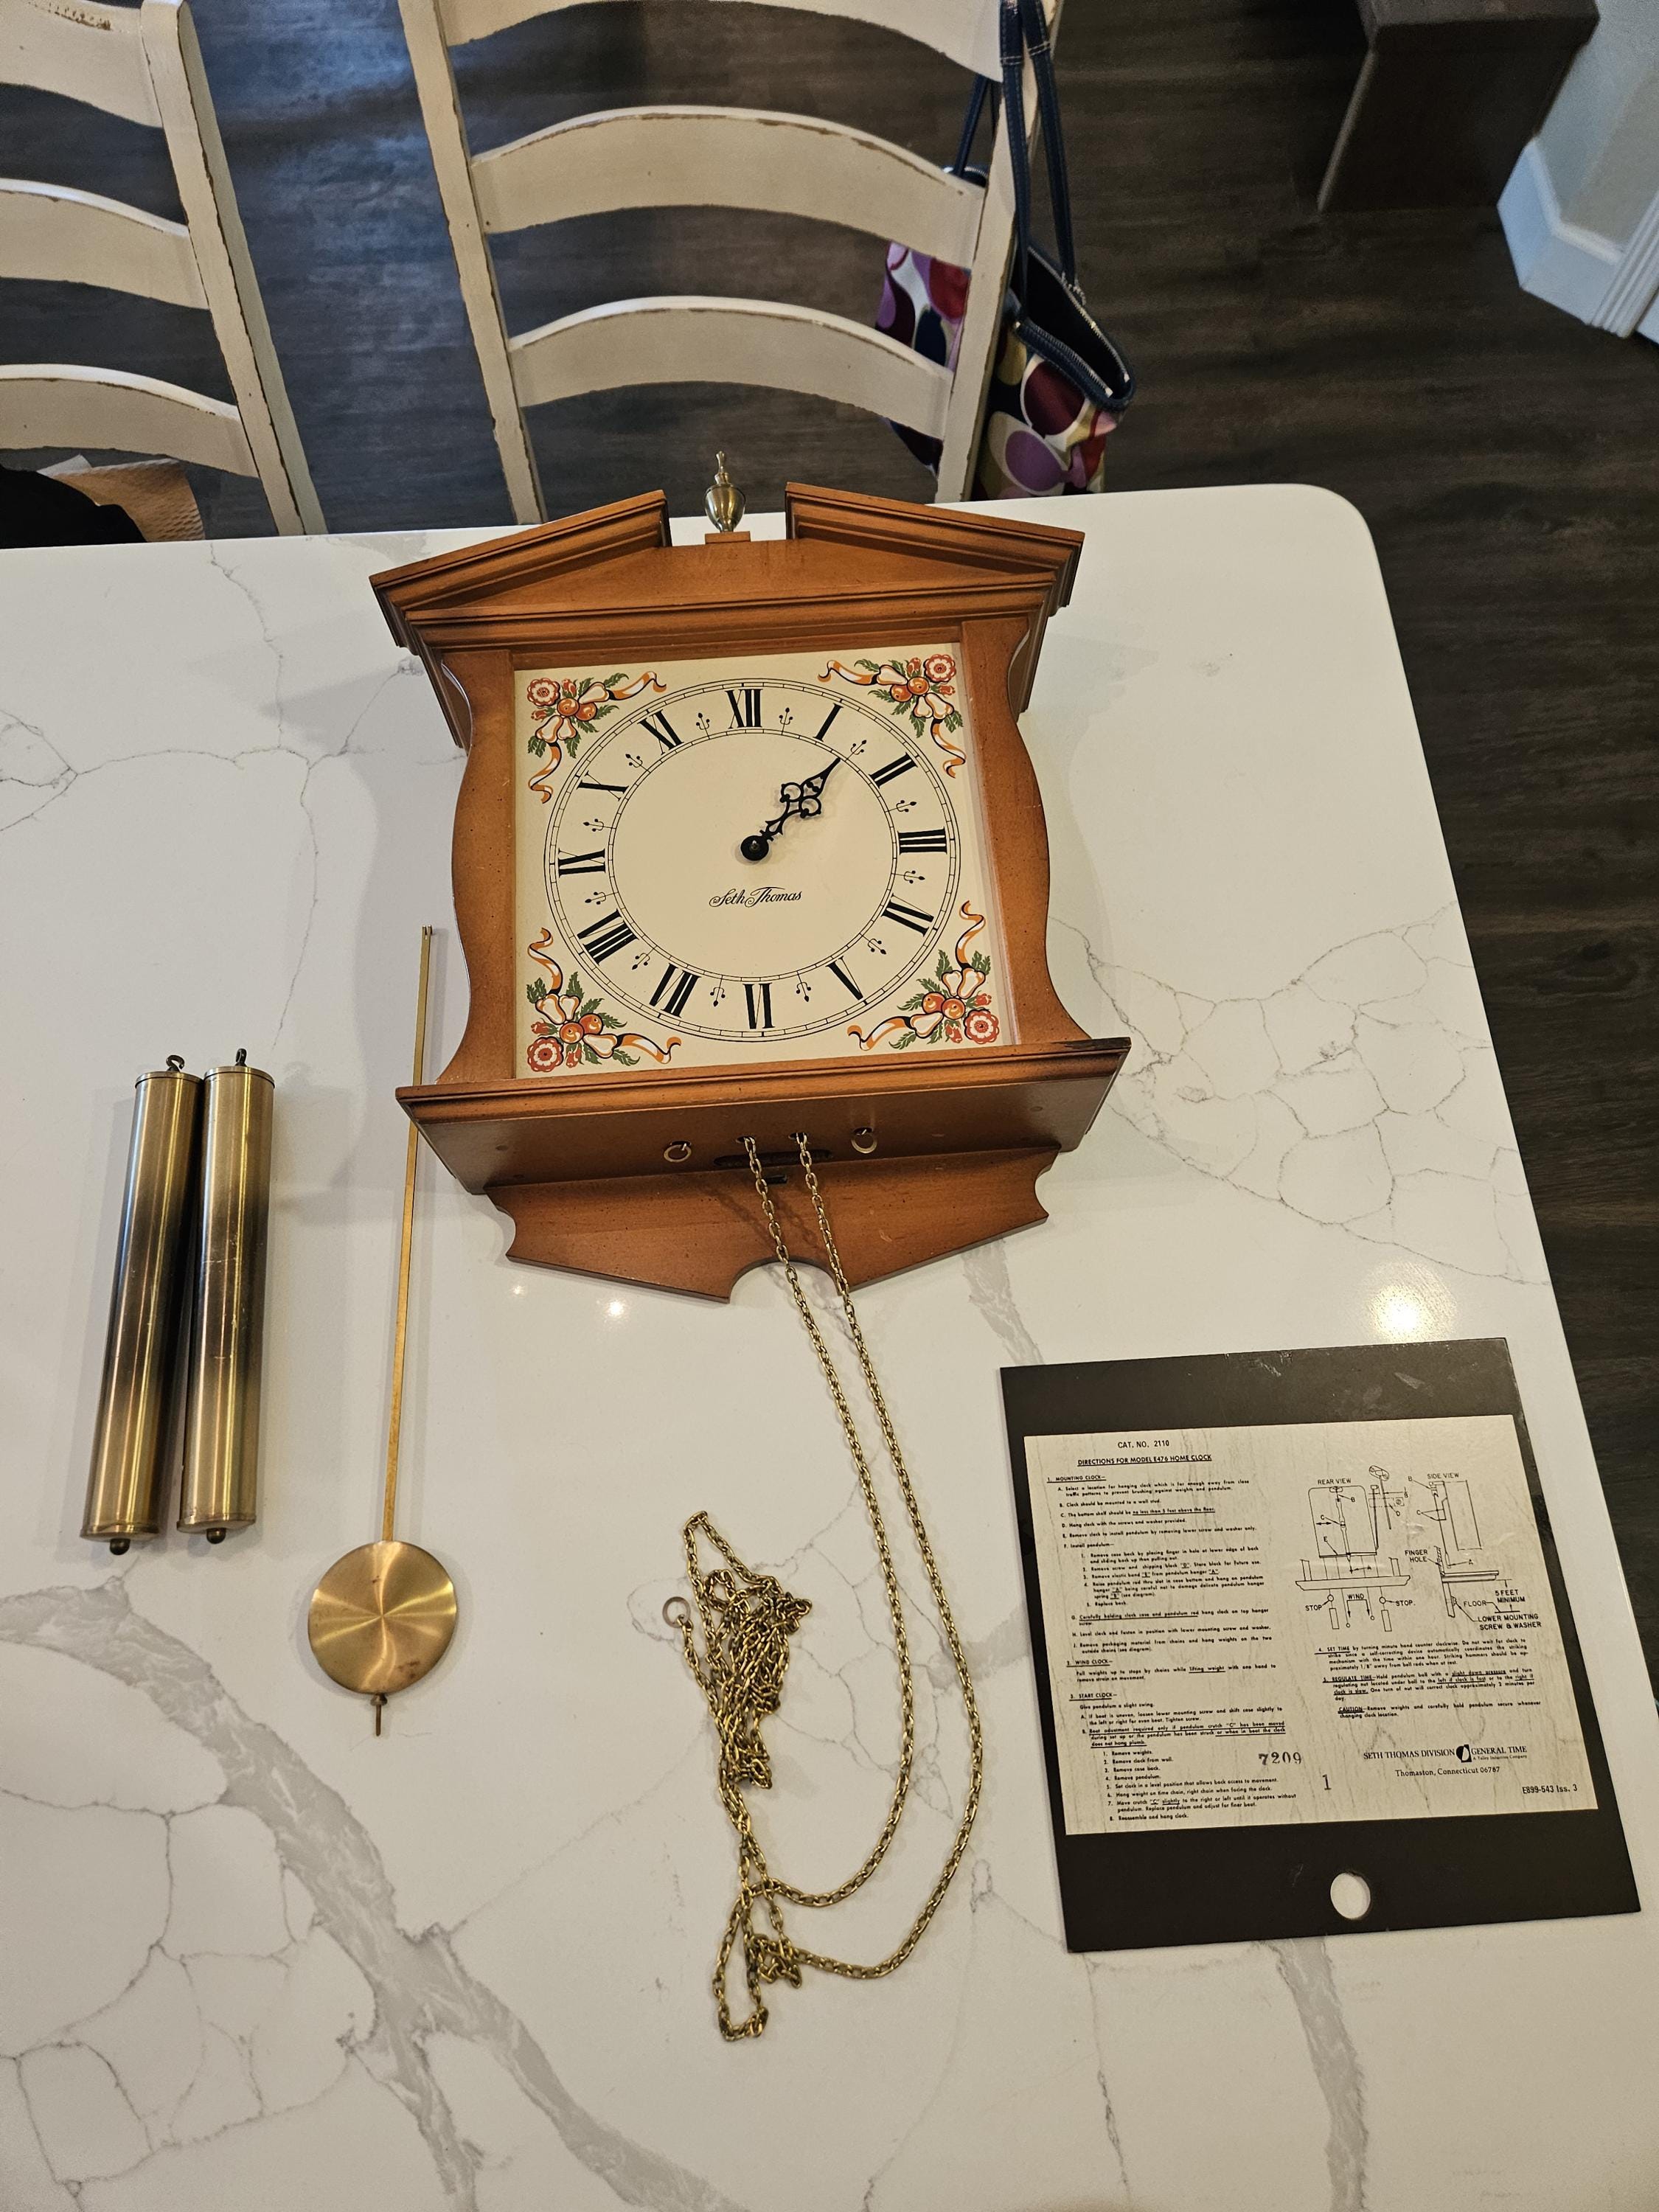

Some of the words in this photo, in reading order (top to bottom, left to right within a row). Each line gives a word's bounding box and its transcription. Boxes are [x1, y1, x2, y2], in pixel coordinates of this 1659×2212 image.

[726, 688, 762, 728] XII
[639, 709, 684, 754] XI
[815, 704, 843, 741] I
[870, 754, 917, 787] II
[576, 771, 628, 801] X
[899, 828, 950, 854] III
[557, 849, 605, 877] IX
[709, 888, 745, 907] Seth
[745, 887, 802, 908] Thomas
[881, 894, 933, 936] IV
[578, 911, 637, 964] VIII
[826, 956, 864, 1001] V
[649, 964, 700, 1018] VII
[744, 982, 776, 1029] VI
[1117, 1441, 1134, 1449] CAT.
[1135, 1440, 1150, 1448] NO.
[1153, 1439, 1169, 1447] 2110
[1077, 1457, 1115, 1465] DIRECTIONS
[1462, 1599, 1487, 1607] FLOOR
[1499, 1588, 1519, 1596] FEET
[1477, 1614, 1502, 1622] LOWER
[1503, 1613, 1539, 1621] MOUNTING
[1512, 1621, 1542, 1629] WASHER
[1257, 1750, 1301, 1766] 7209
[1363, 1751, 1383, 1760] SETH
[1383, 1750, 1419, 1759] THOMAS
[1420, 1748, 1455, 1757] DIVISION
[1470, 1746, 1506, 1755] GENERAL
[1506, 1745, 1528, 1753] TIME
[1394, 1767, 1436, 1777] Thomaston,
[1436, 1766, 1479, 1775] Connecticut
[1479, 1765, 1500, 1773] 06787
[1523, 1785, 1554, 1794] E899-543
